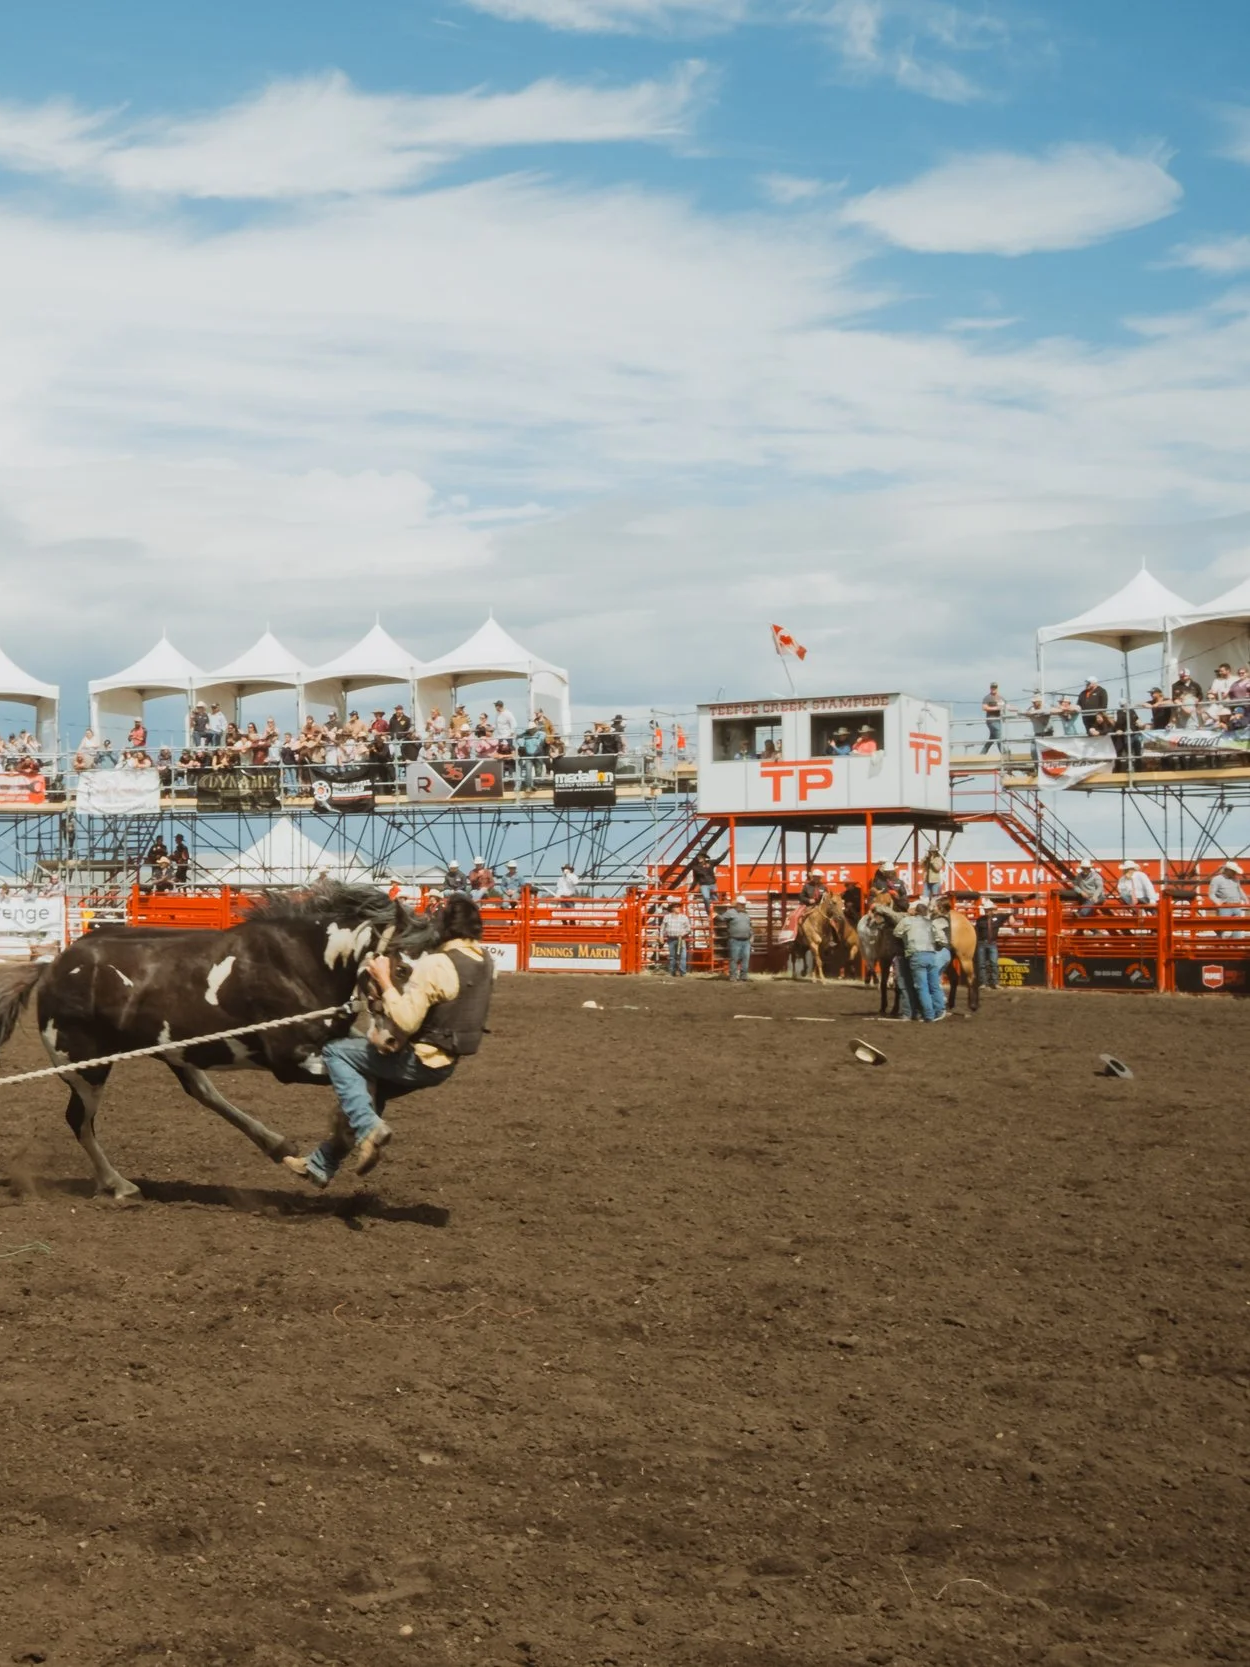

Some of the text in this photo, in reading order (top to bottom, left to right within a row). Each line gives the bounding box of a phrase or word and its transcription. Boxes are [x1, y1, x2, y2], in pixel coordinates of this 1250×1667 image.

[709, 696, 889, 716] TEEPEE CREEK STAMPEDE
[908, 740, 943, 776] TP
[554, 769, 614, 784] medallion
[760, 768, 834, 802] TP
[776, 868, 850, 886] TEEEE
[531, 943, 619, 959] JENNINGS MARTIN
